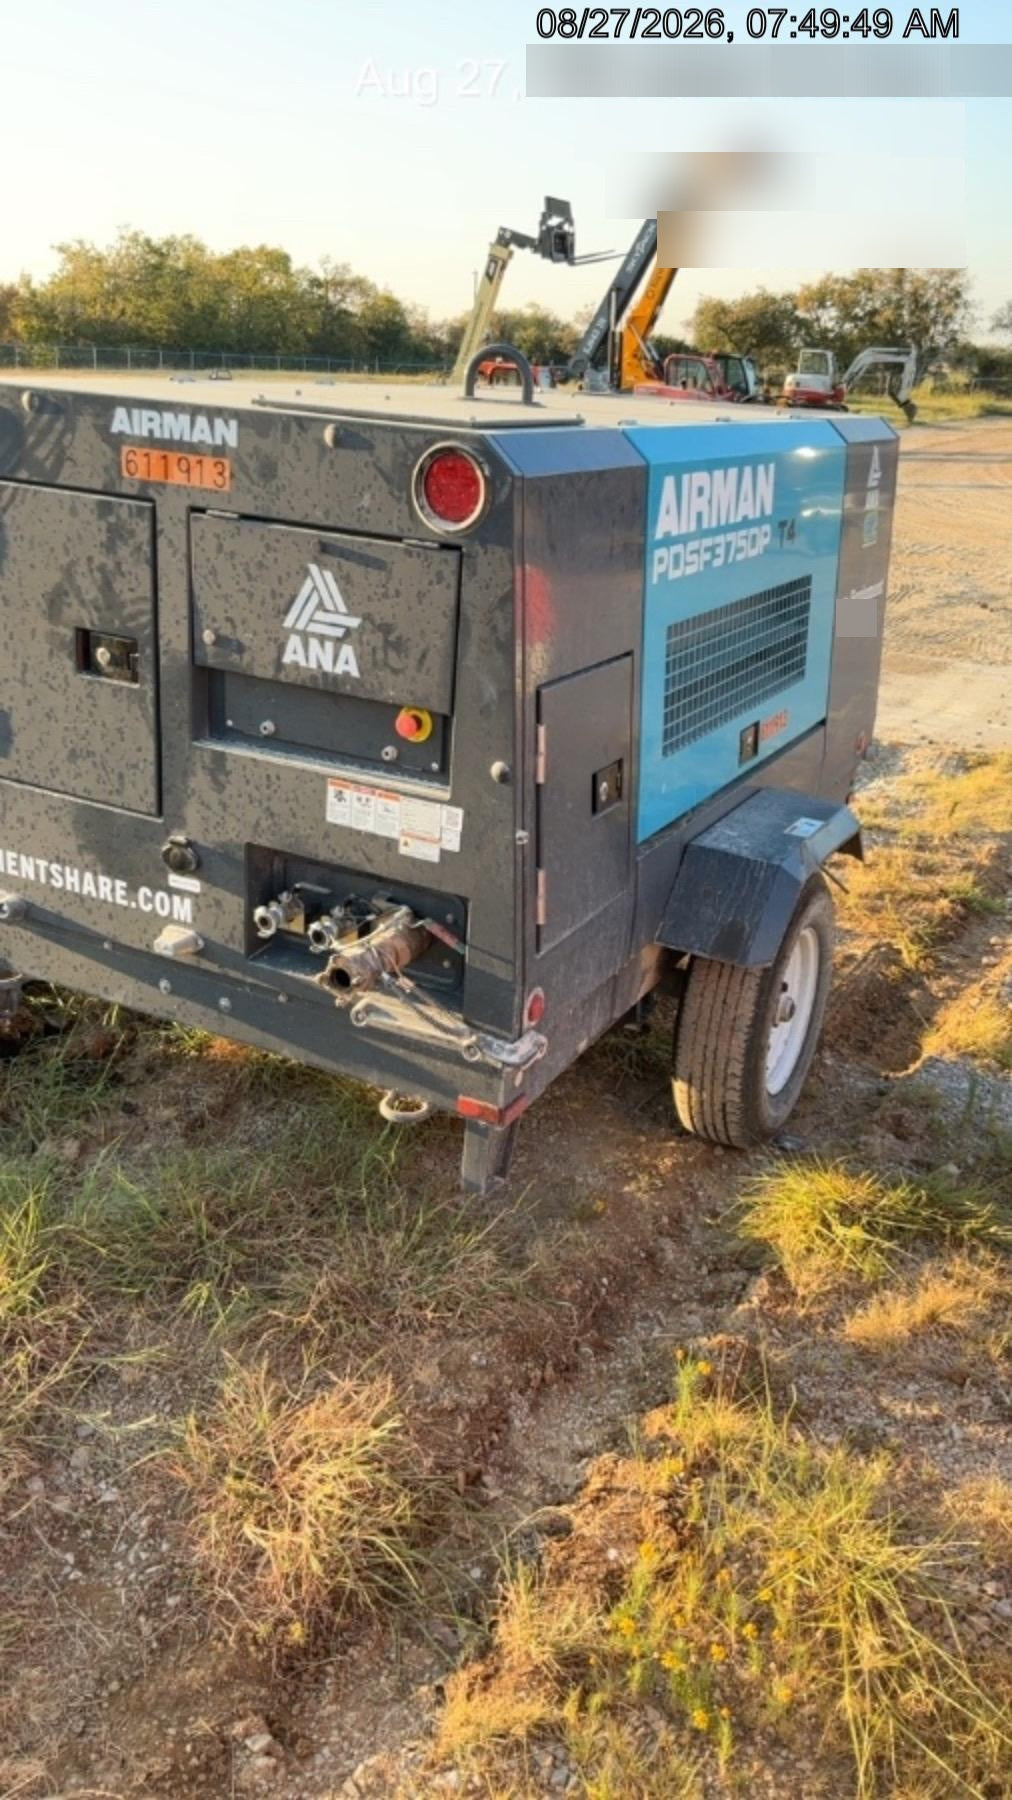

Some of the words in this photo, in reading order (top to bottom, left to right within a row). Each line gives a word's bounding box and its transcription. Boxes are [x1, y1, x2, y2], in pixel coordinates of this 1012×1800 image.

[111, 407, 238, 448] AIRMAN
[125, 449, 228, 489] 611913
[655, 463, 775, 540] AIRMAN
[282, 633, 360, 678] ANA
[0, 848, 193, 923] ENTSHARE.COM
